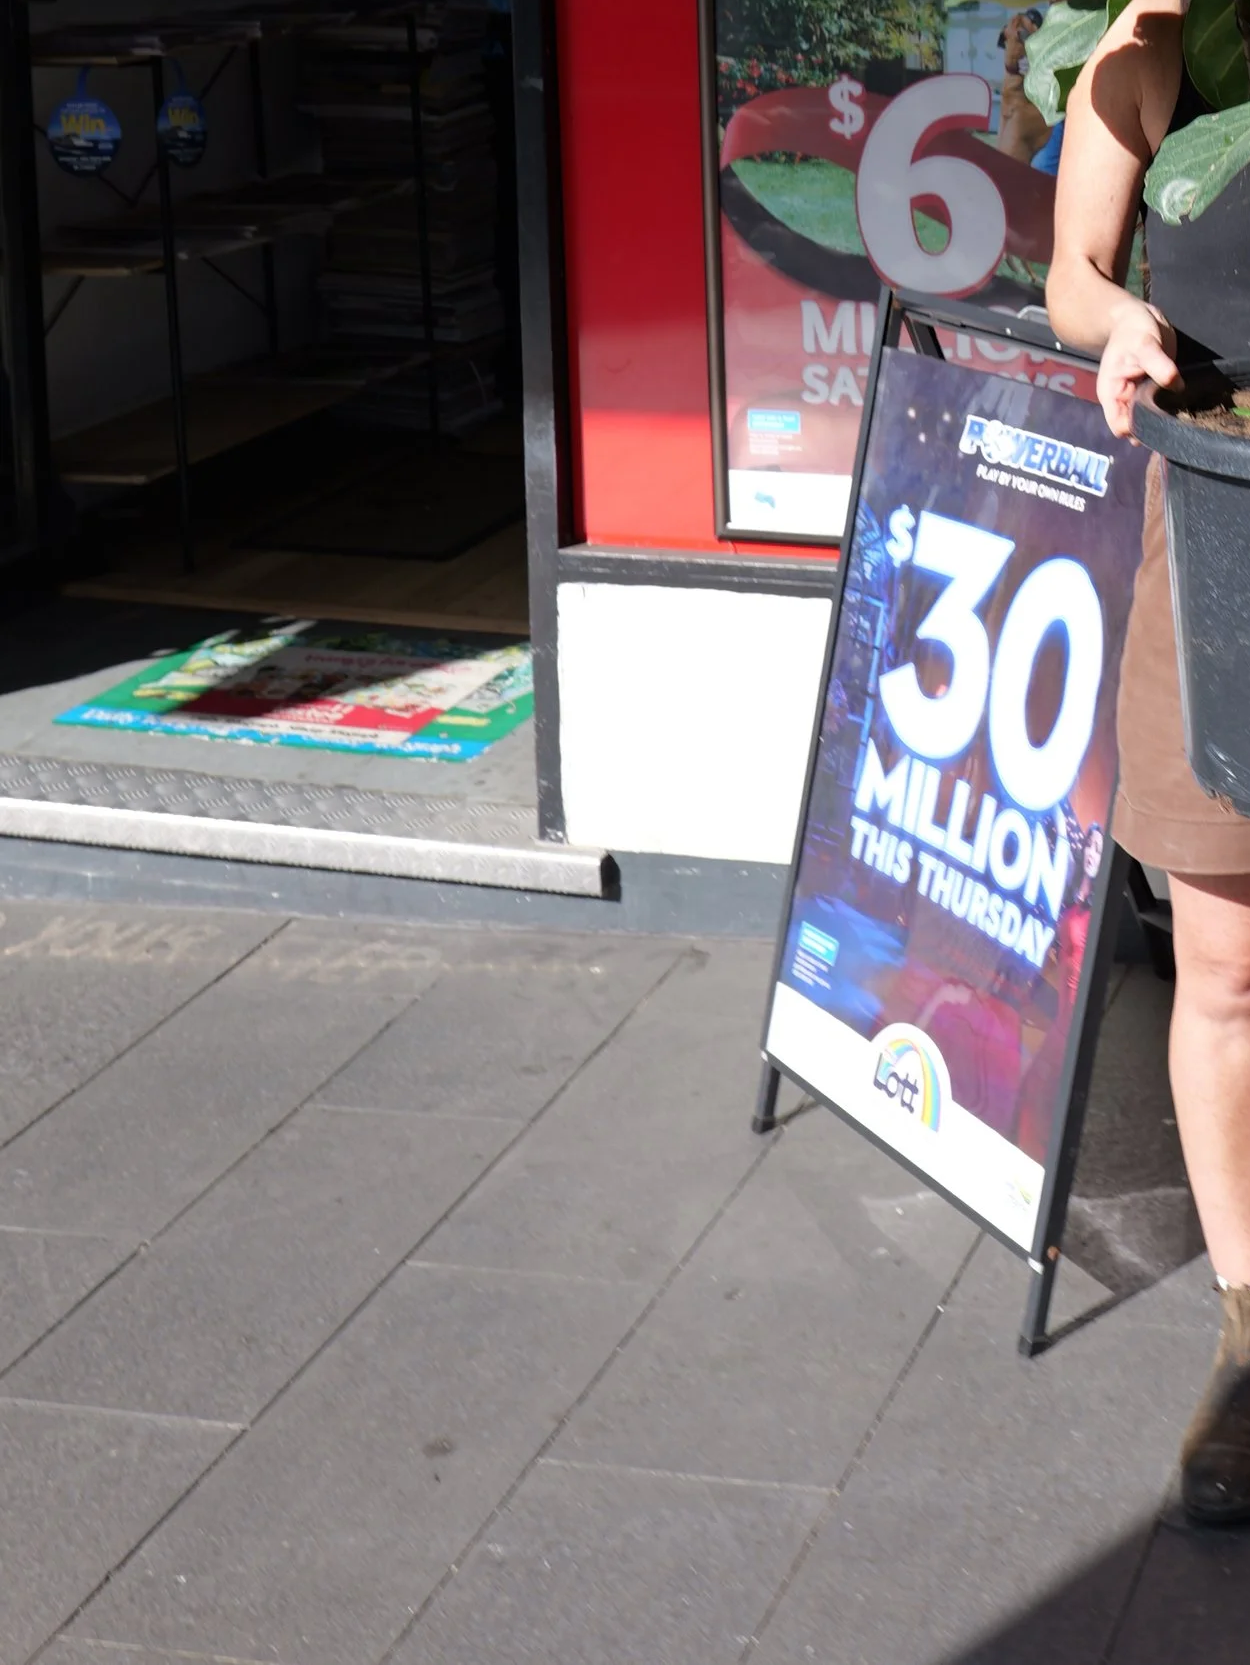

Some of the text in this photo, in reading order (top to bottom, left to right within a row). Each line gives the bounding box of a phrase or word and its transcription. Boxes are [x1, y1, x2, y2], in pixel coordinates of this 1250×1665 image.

[1011, 475, 1038, 496] YOUR
[1038, 482, 1060, 502] OWN
[1059, 491, 1087, 512] RULES
[880, 503, 1103, 812] $30
[850, 815, 914, 884] THIS
[917, 850, 1055, 968] THURSDAY
[854, 737, 1071, 922] MILLION
[873, 1051, 920, 1114] Lott
